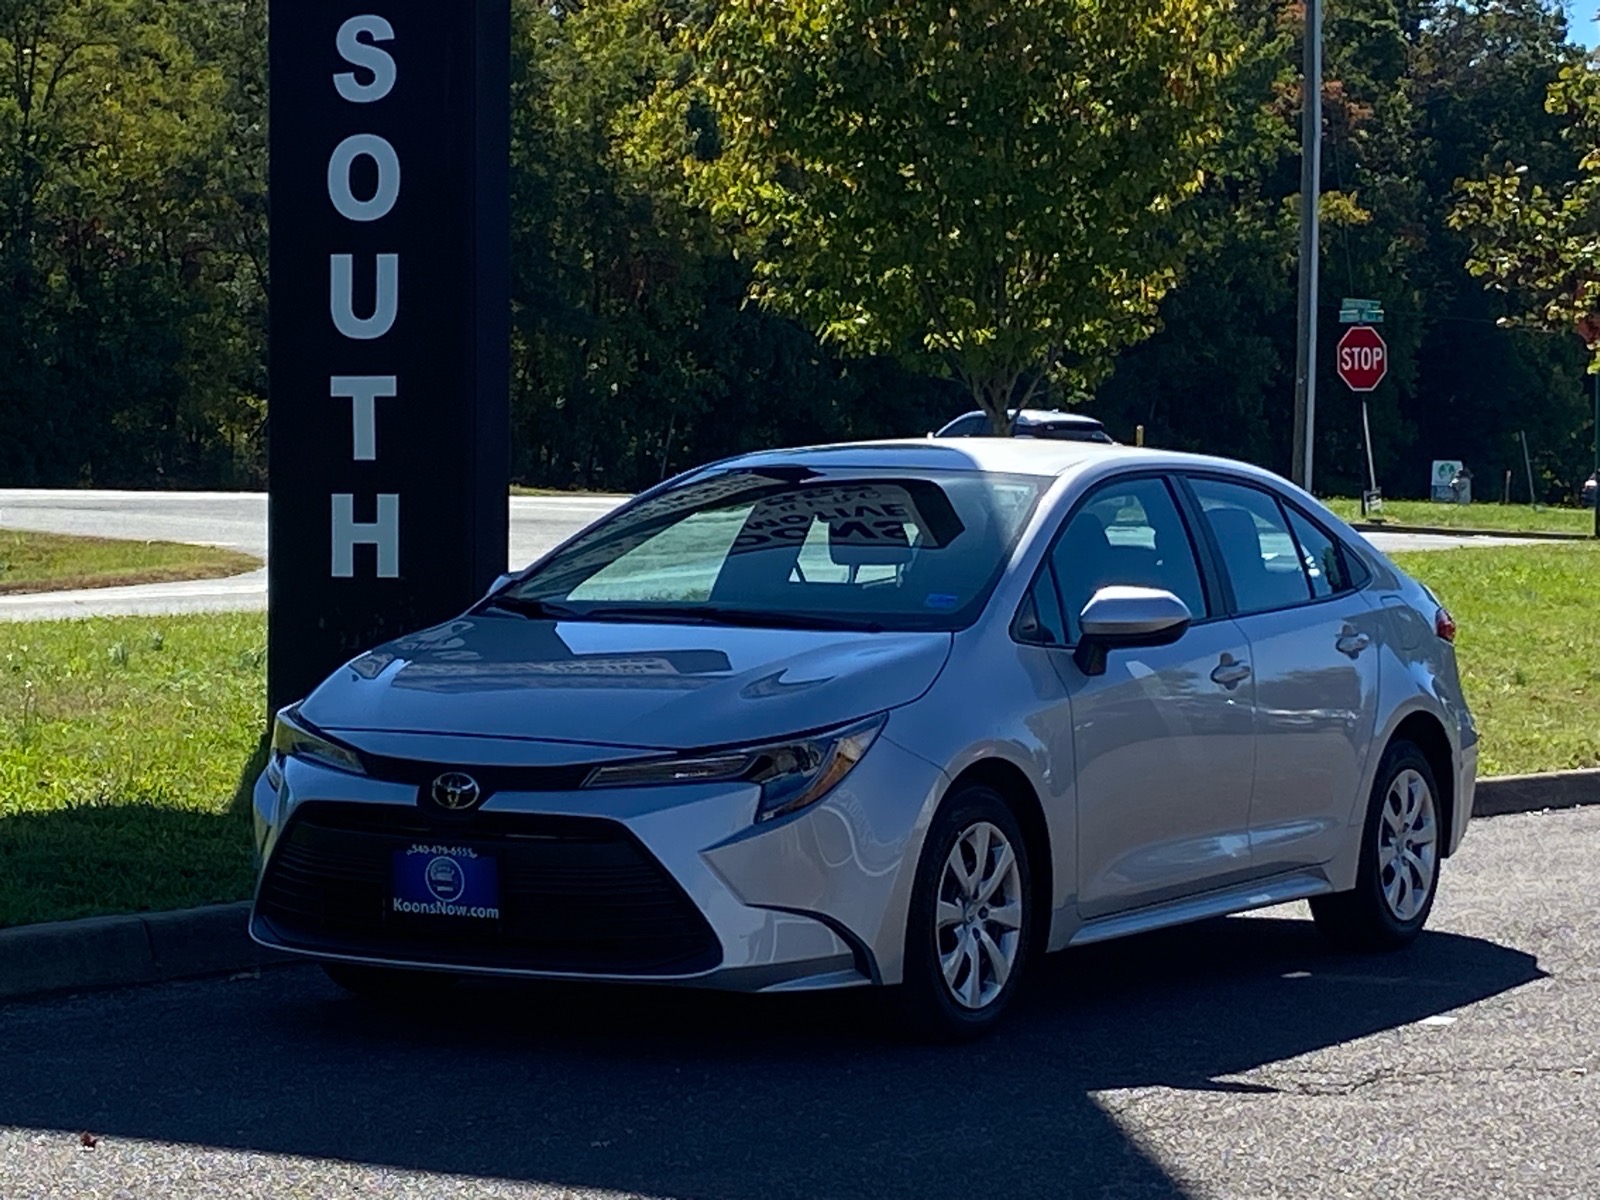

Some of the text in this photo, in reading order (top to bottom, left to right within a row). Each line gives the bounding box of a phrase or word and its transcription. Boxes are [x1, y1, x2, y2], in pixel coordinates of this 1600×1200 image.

[327, 14, 401, 578] SOUTH
[1341, 347, 1383, 371] STOP
[393, 897, 499, 919] KoonsNow.com
